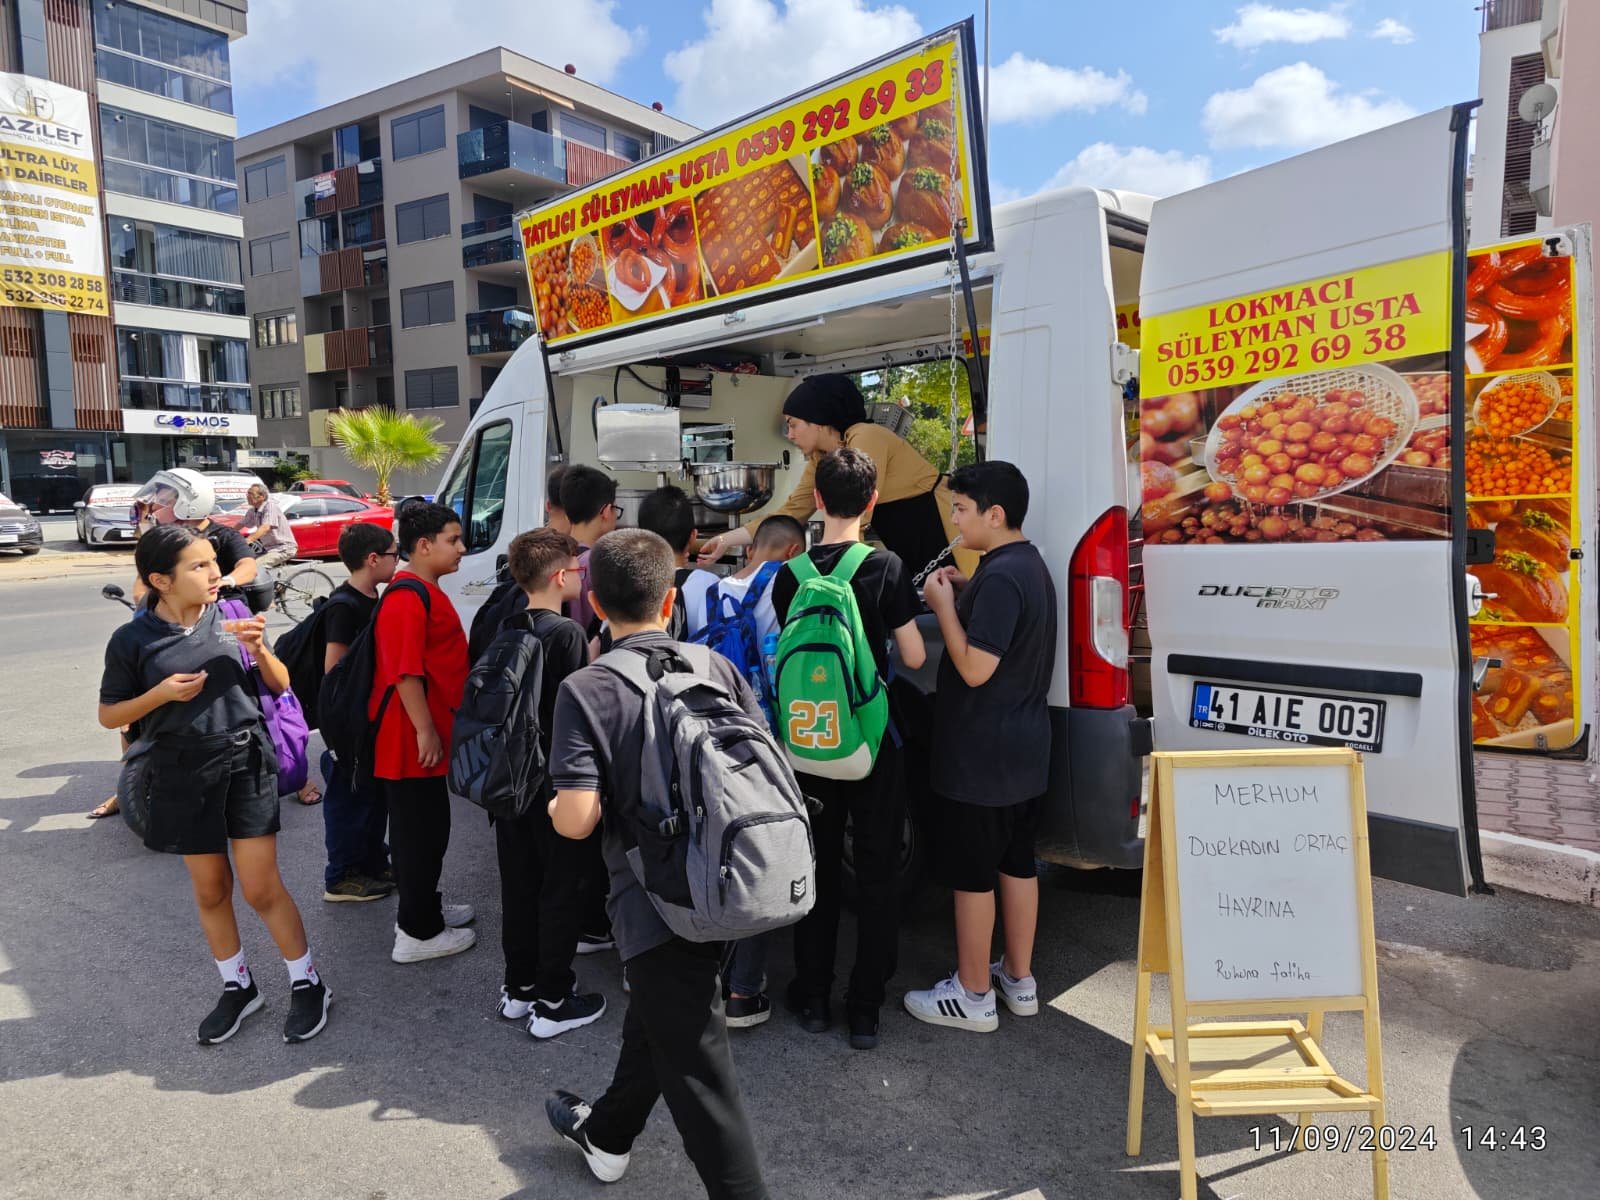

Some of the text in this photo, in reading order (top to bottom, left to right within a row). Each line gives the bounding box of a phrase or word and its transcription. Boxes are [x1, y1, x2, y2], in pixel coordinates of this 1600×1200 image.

[52, 157, 79, 174] LÜX
[523, 60, 944, 248] TATLICI SÜLEYMAN USTA 0539 292 69 38
[4, 269, 102, 293] 532 308 28 58
[5, 289, 35, 302] 532
[70, 295, 83, 308] 22
[88, 297, 104, 310] 74
[1208, 277, 1354, 328] LOKMACI
[1157, 315, 1317, 363] SÜLEYMAN
[1329, 292, 1422, 330] USTA
[1168, 324, 1407, 387] 0539 292 69 38
[1198, 585, 1340, 600] DUCATO
[1256, 599, 1328, 610] MAXI
[788, 700, 841, 749] 23
[1197, 690, 1375, 739] TR 41 AIE 003
[1283, 732, 1309, 743] OTO
[1215, 783, 1319, 806] MERHUM
[1293, 834, 1350, 855] ORTAÇ
[1218, 892, 1295, 919] HAYRINA
